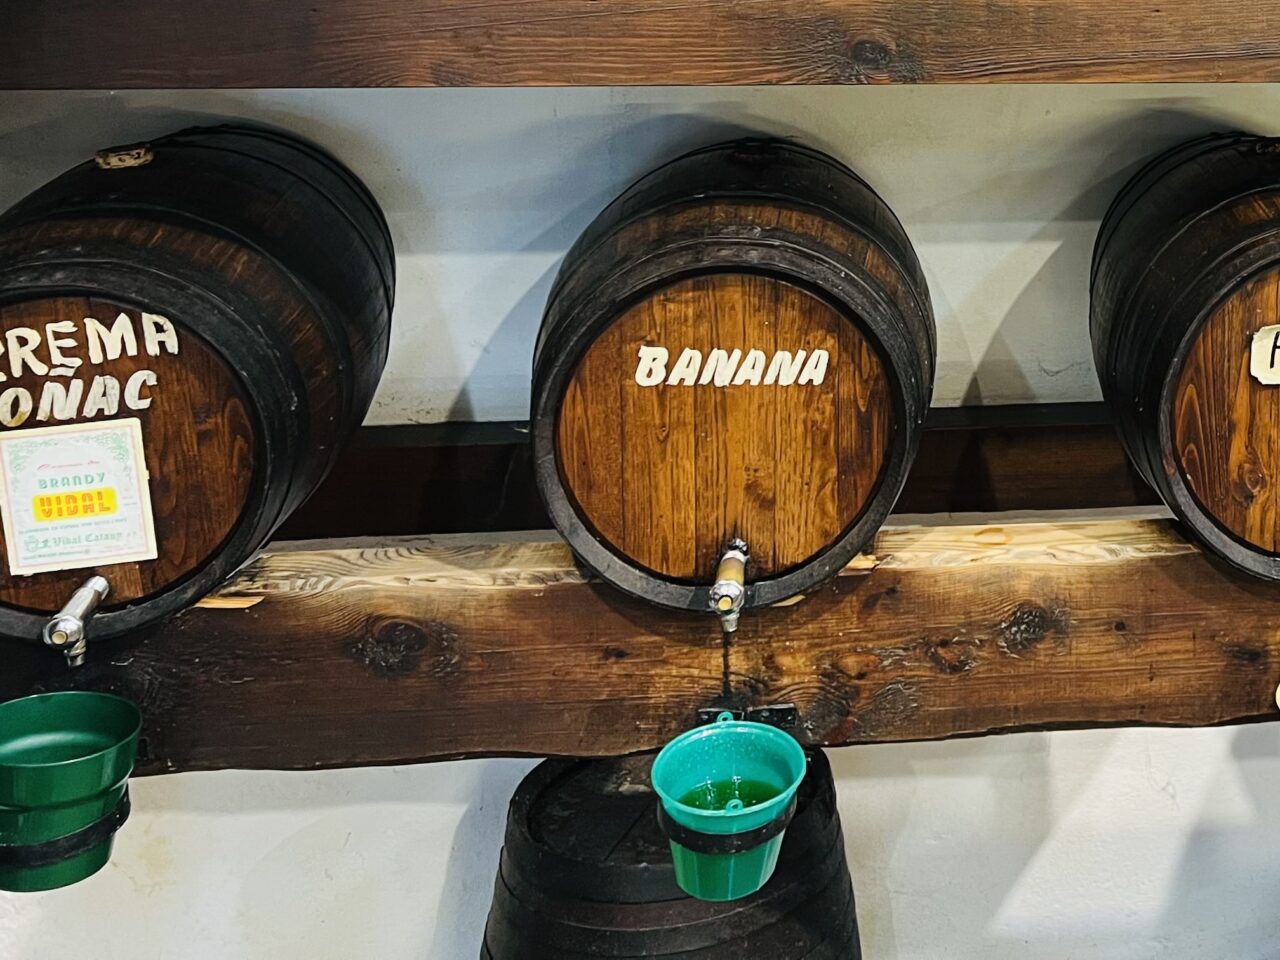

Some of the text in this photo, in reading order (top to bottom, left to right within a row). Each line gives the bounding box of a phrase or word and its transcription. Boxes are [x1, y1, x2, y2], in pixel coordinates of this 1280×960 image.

[0, 312, 180, 378] REMA
[635, 345, 829, 388] BANANA
[0, 367, 158, 427] OÑAC
[37, 471, 106, 490] BRANDY
[39, 491, 112, 519] VIDAL
